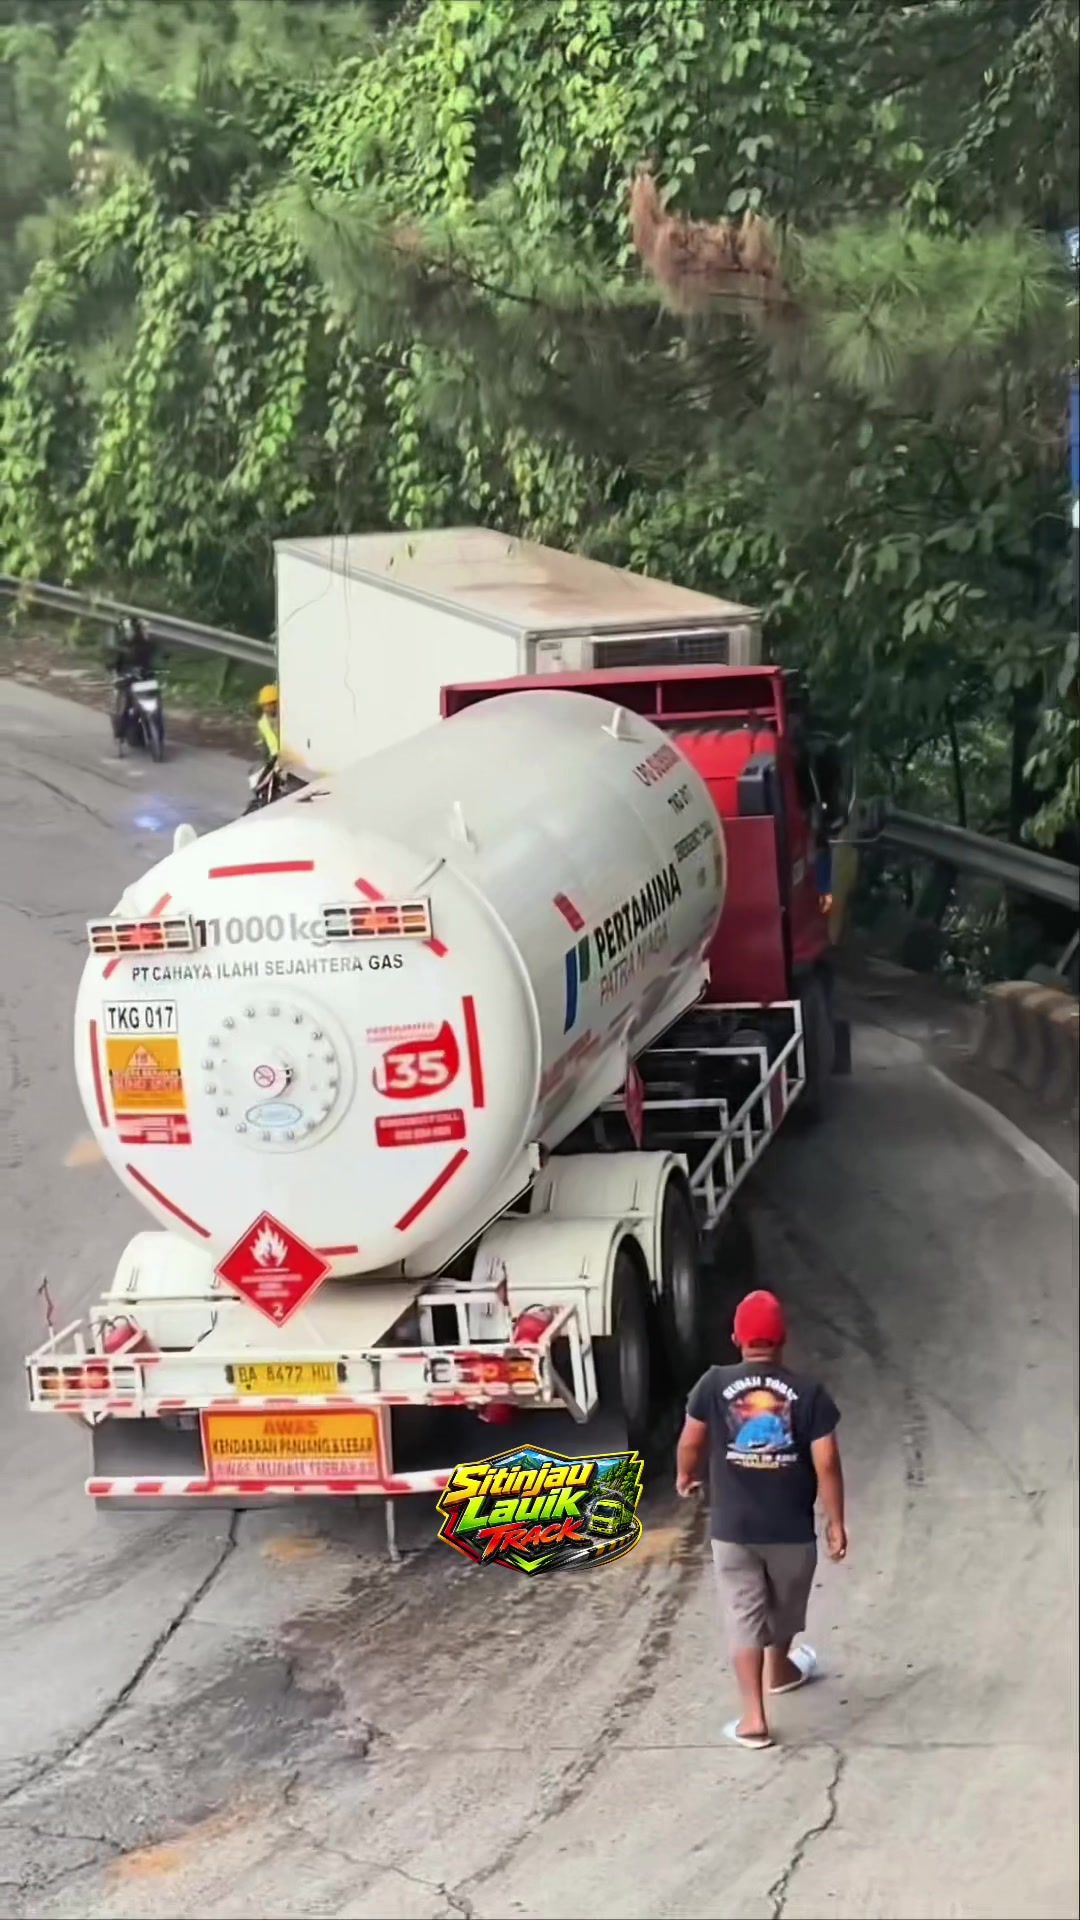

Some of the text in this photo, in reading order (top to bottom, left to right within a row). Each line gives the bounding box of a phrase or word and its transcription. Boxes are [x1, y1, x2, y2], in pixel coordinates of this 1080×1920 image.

[593, 863, 682, 969] PERTAMINA
[195, 914, 284, 947] 11000
[132, 954, 404, 982] PT CAHAYA ILAHI SEJAHTERA GAS
[108, 1005, 173, 1029] TKG 017
[272, 1302, 284, 1317] 2
[238, 1366, 257, 1383] BA
[263, 1419, 320, 1435] AWAS
[213, 1438, 277, 1455] KENDARAAN
[279, 1438, 331, 1454] PANJANG
